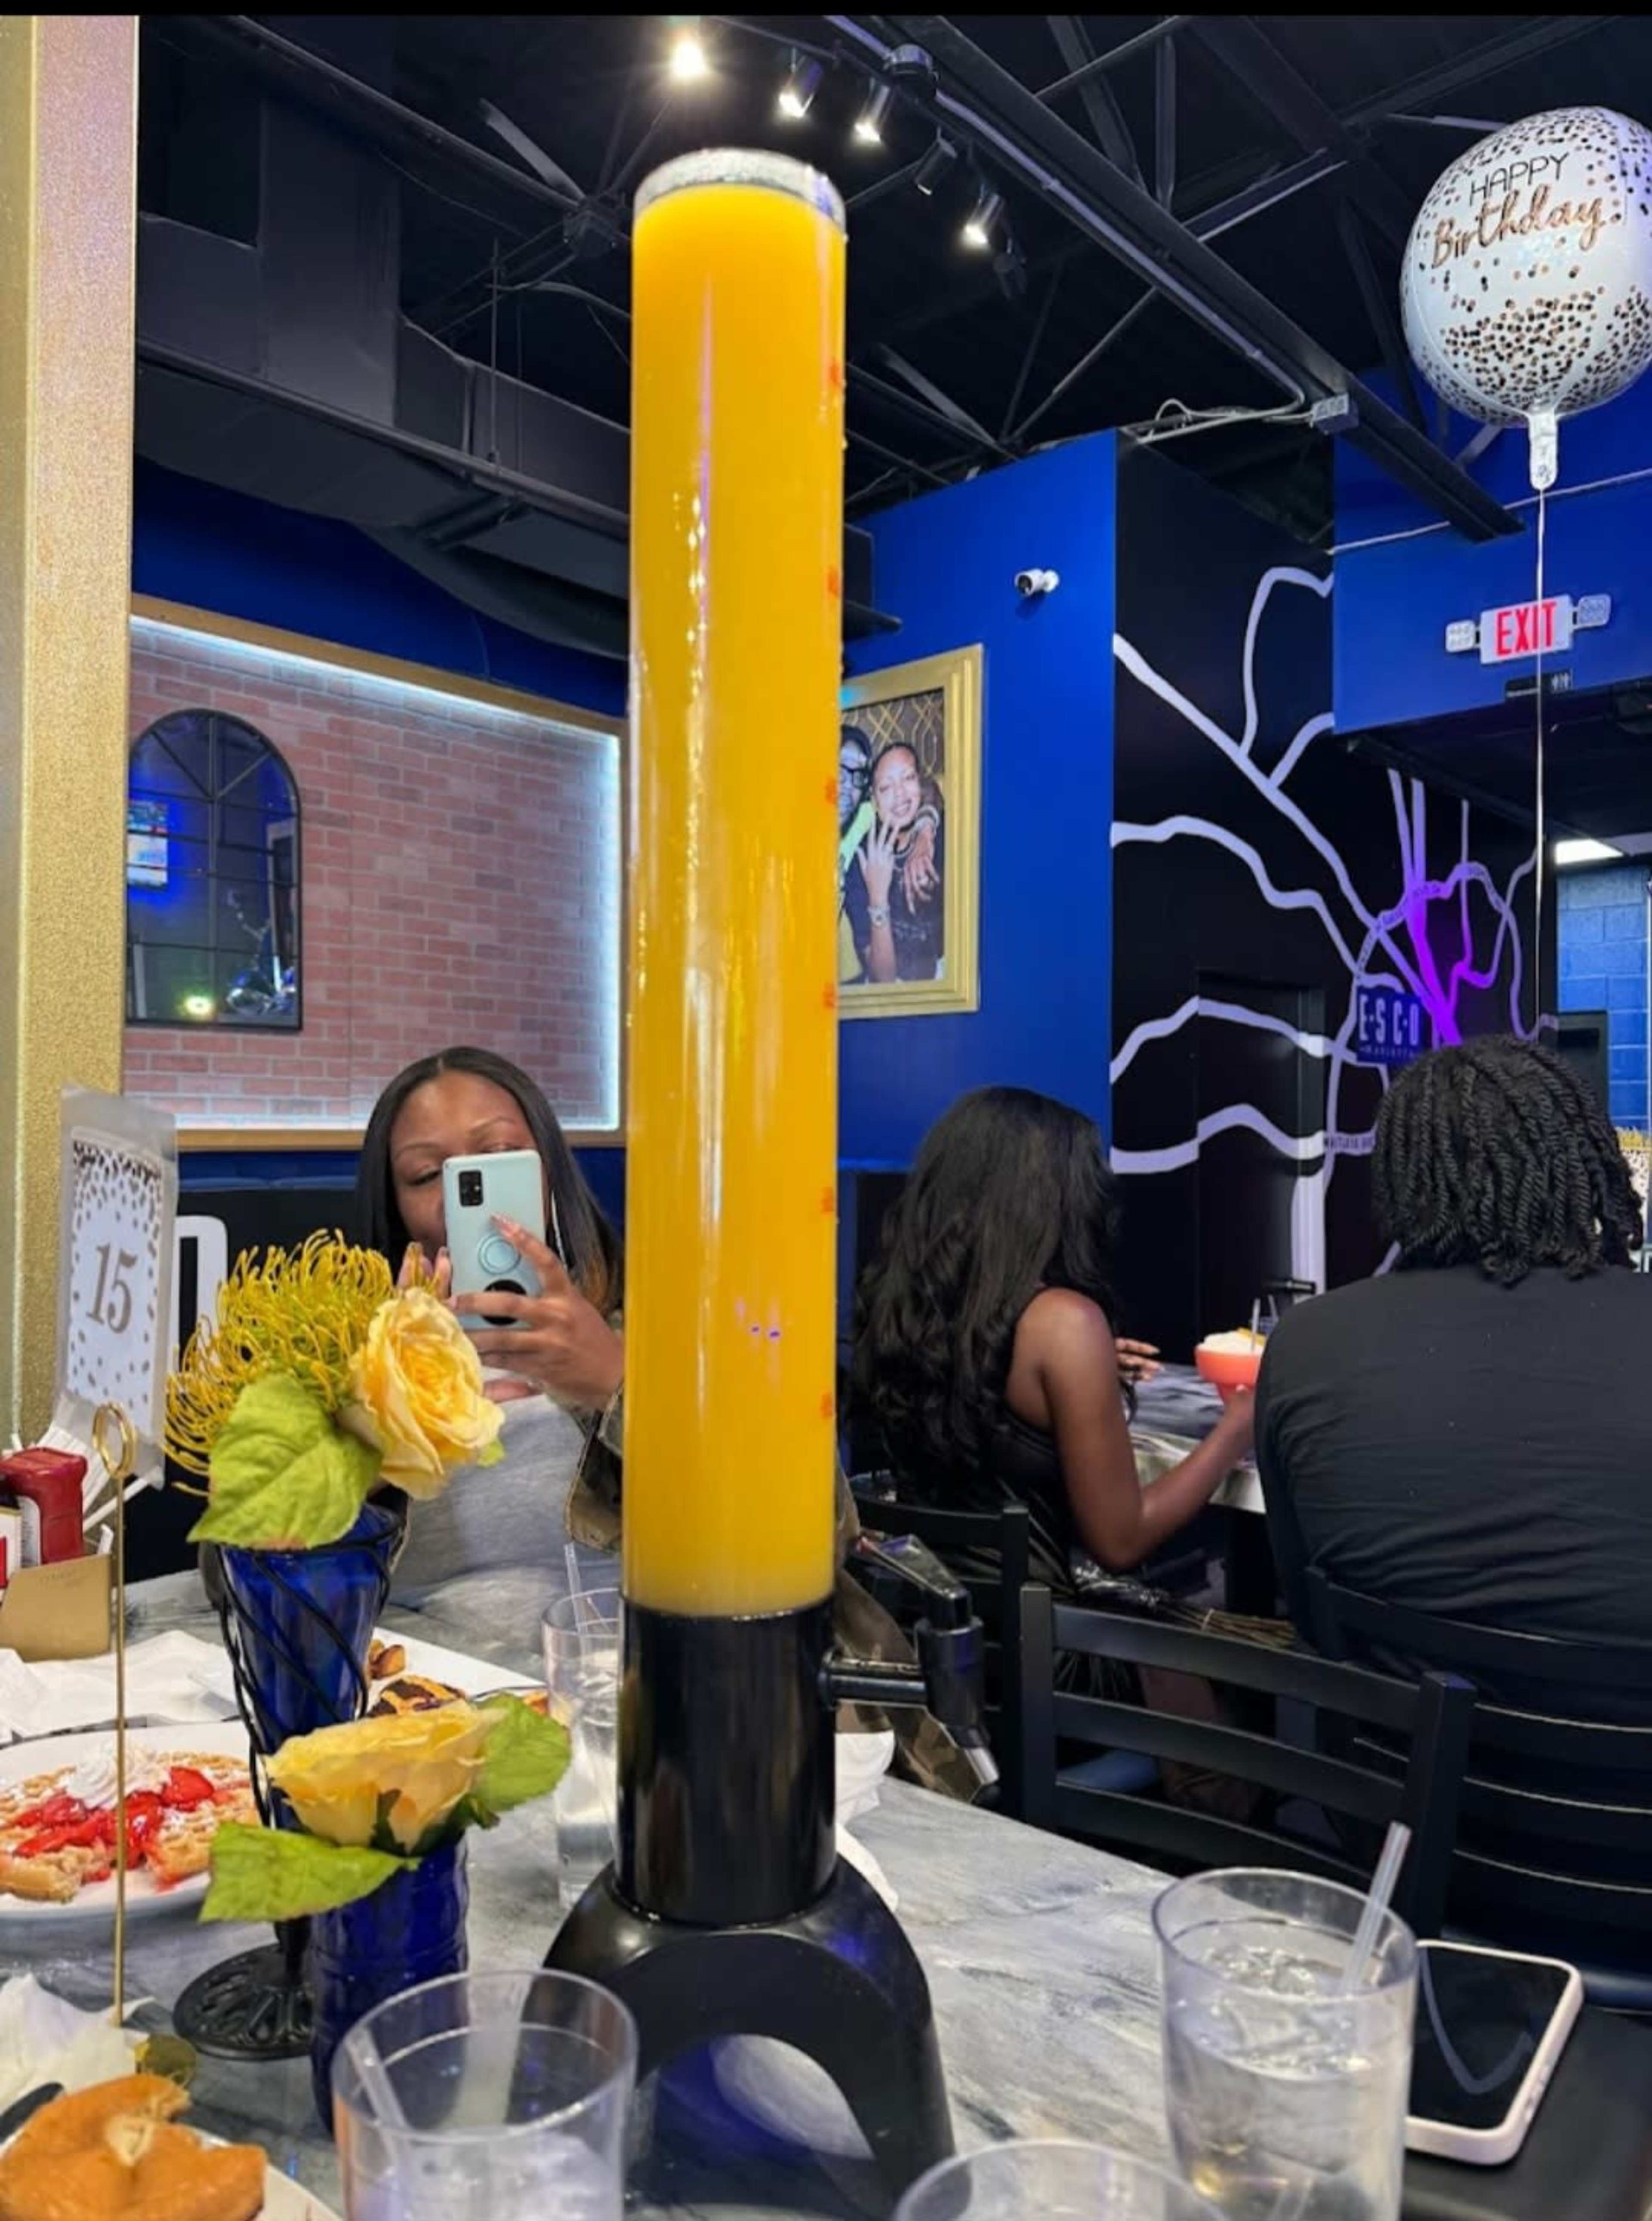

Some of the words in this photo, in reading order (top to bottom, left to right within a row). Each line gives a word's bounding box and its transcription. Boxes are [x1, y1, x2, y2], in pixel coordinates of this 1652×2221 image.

[1470, 152, 1569, 207] HAPPY
[1432, 183, 1606, 269] Birthday
[1497, 601, 1556, 657] EXIT
[85, 1243, 138, 1334] 15
